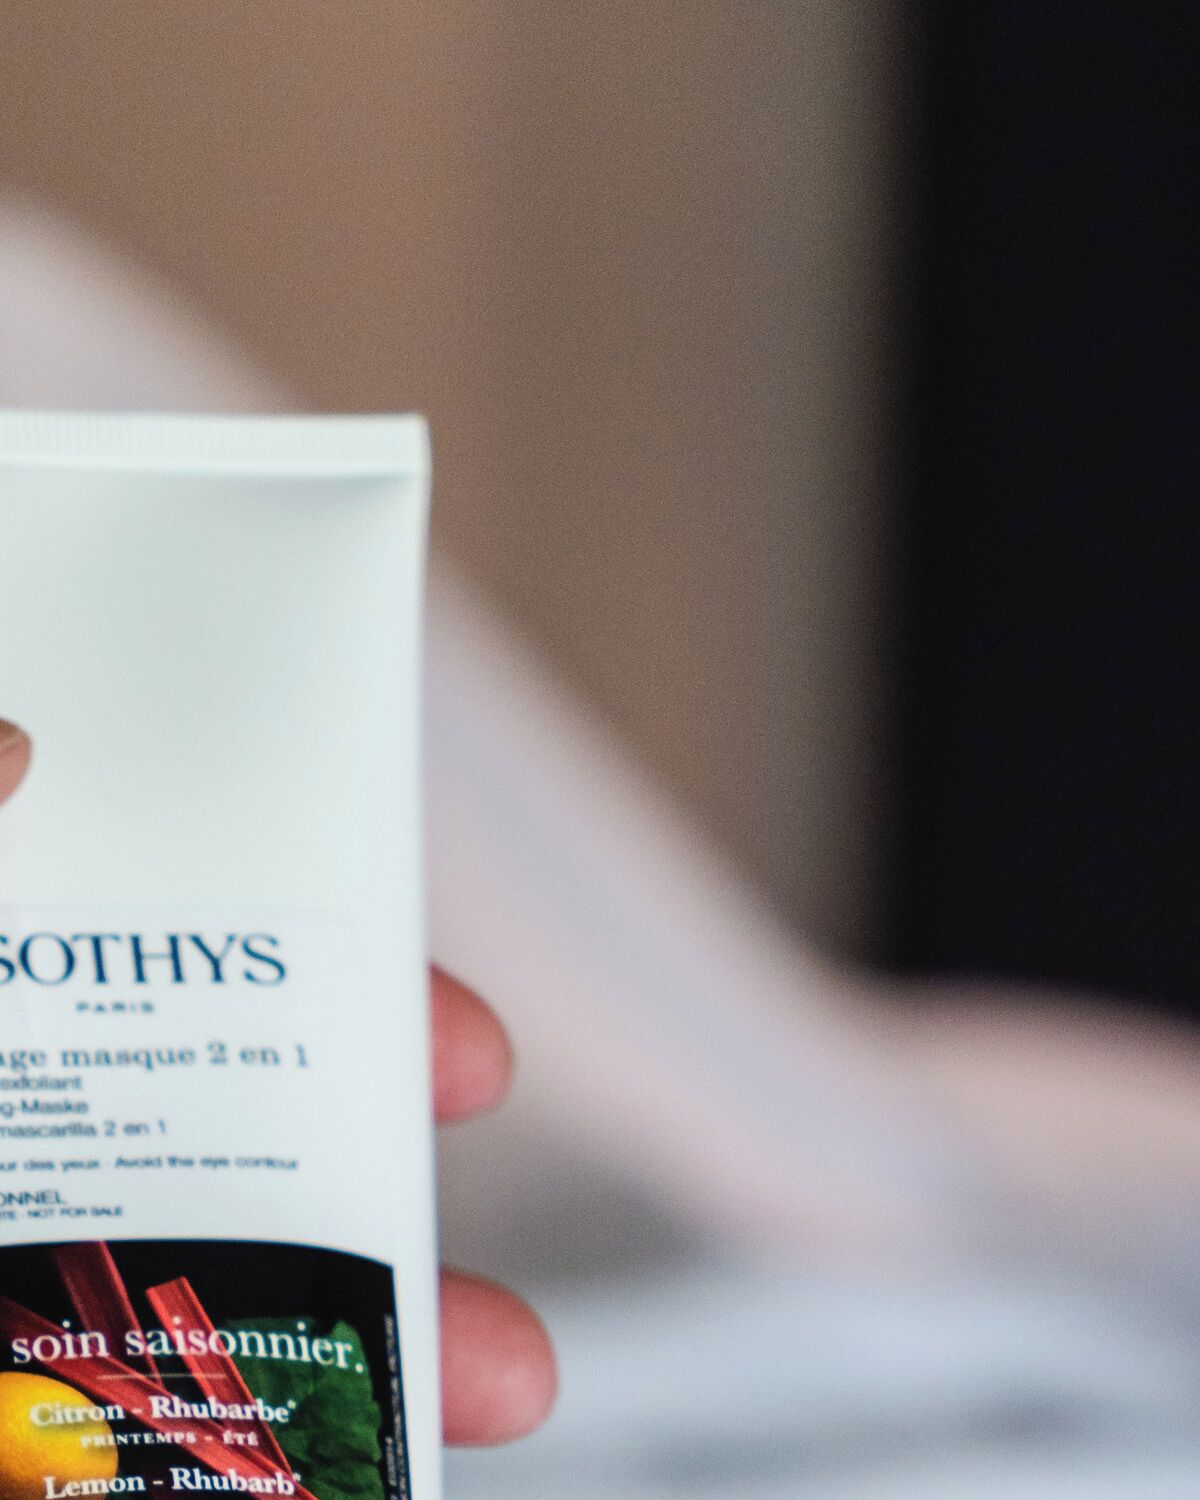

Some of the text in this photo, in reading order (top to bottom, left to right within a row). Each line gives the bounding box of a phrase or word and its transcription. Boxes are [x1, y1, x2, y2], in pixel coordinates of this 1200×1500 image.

[74, 1000, 155, 1014] PARIS
[61, 1048, 196, 1072] masque
[207, 1041, 228, 1065] 2
[239, 1047, 280, 1065] en
[294, 1043, 309, 1068] 1
[103, 1120, 116, 1137] 2
[123, 1122, 150, 1136] en
[157, 1119, 167, 1135] 1
[24, 1158, 55, 1171] des
[60, 1158, 100, 1173] yeux
[115, 1155, 162, 1169] Avoid
[167, 1155, 194, 1168] the
[201, 1156, 229, 1171] eye
[235, 1156, 298, 1170] contour
[28, 1207, 54, 1219] NOT
[60, 1206, 87, 1217] FOR
[91, 1205, 123, 1217] SALE
[10, 1320, 109, 1365] soin
[124, 1315, 366, 1374] saisonnier.
[29, 1401, 126, 1427] Citron
[80, 1431, 197, 1449] PRINTEMPS
[223, 1429, 260, 1447] ÉTÉ
[43, 1474, 146, 1500] Lemon
